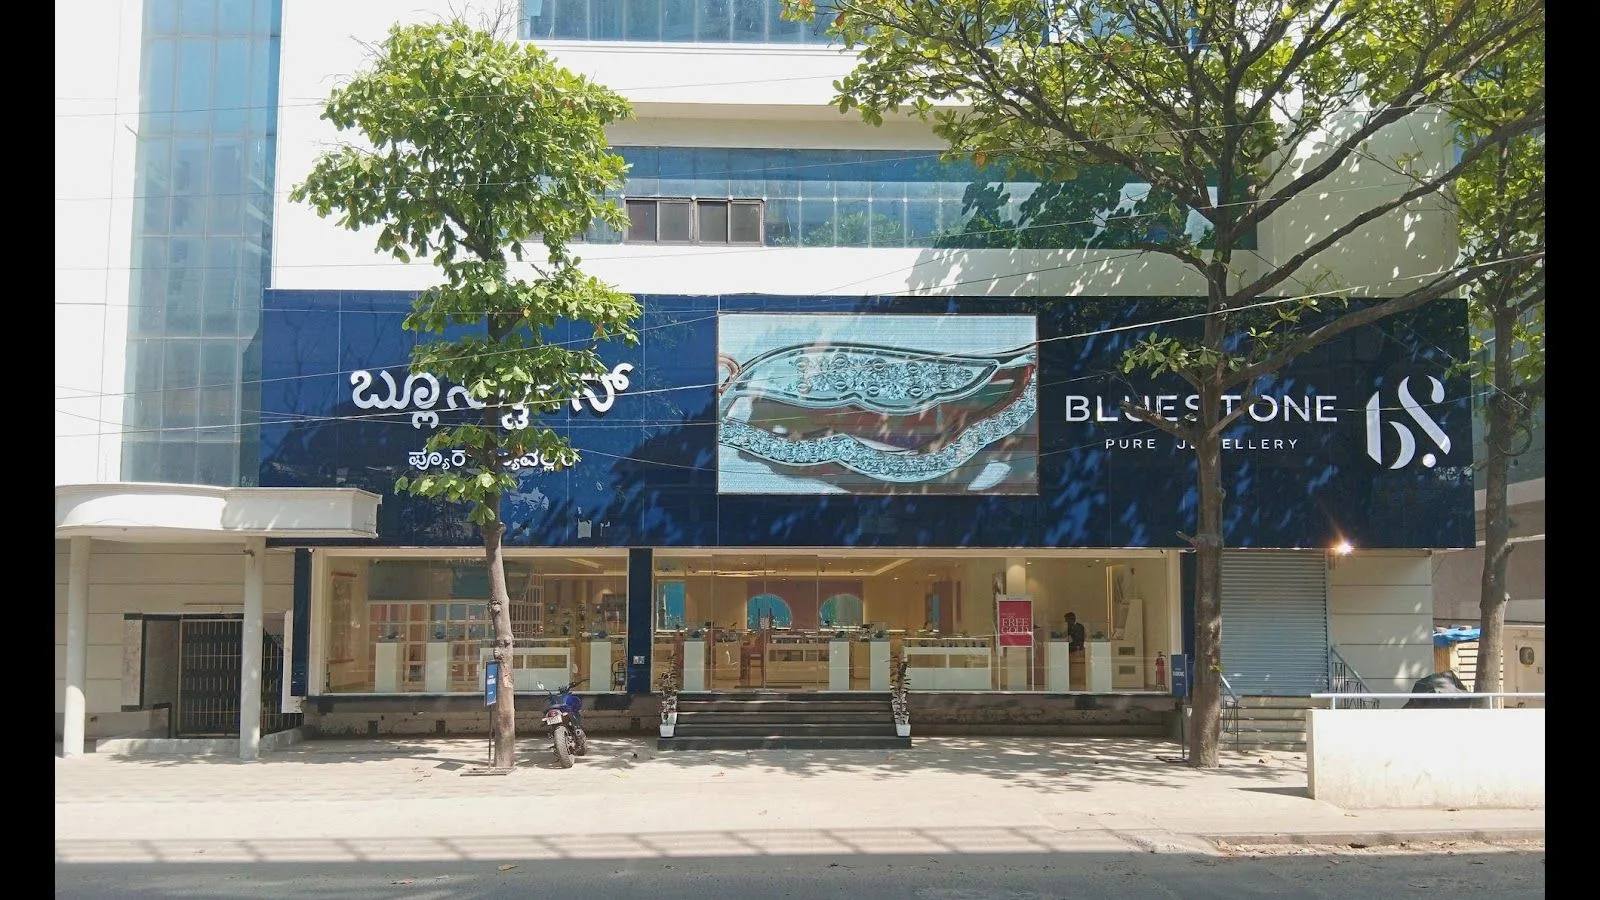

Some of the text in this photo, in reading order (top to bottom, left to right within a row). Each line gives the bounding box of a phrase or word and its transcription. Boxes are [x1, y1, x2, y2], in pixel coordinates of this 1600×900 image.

[1065, 394, 1338, 423] BLUESTONE
[1105, 438, 1299, 450] PURE JELLERY
[1001, 617, 1029, 627] FREE
